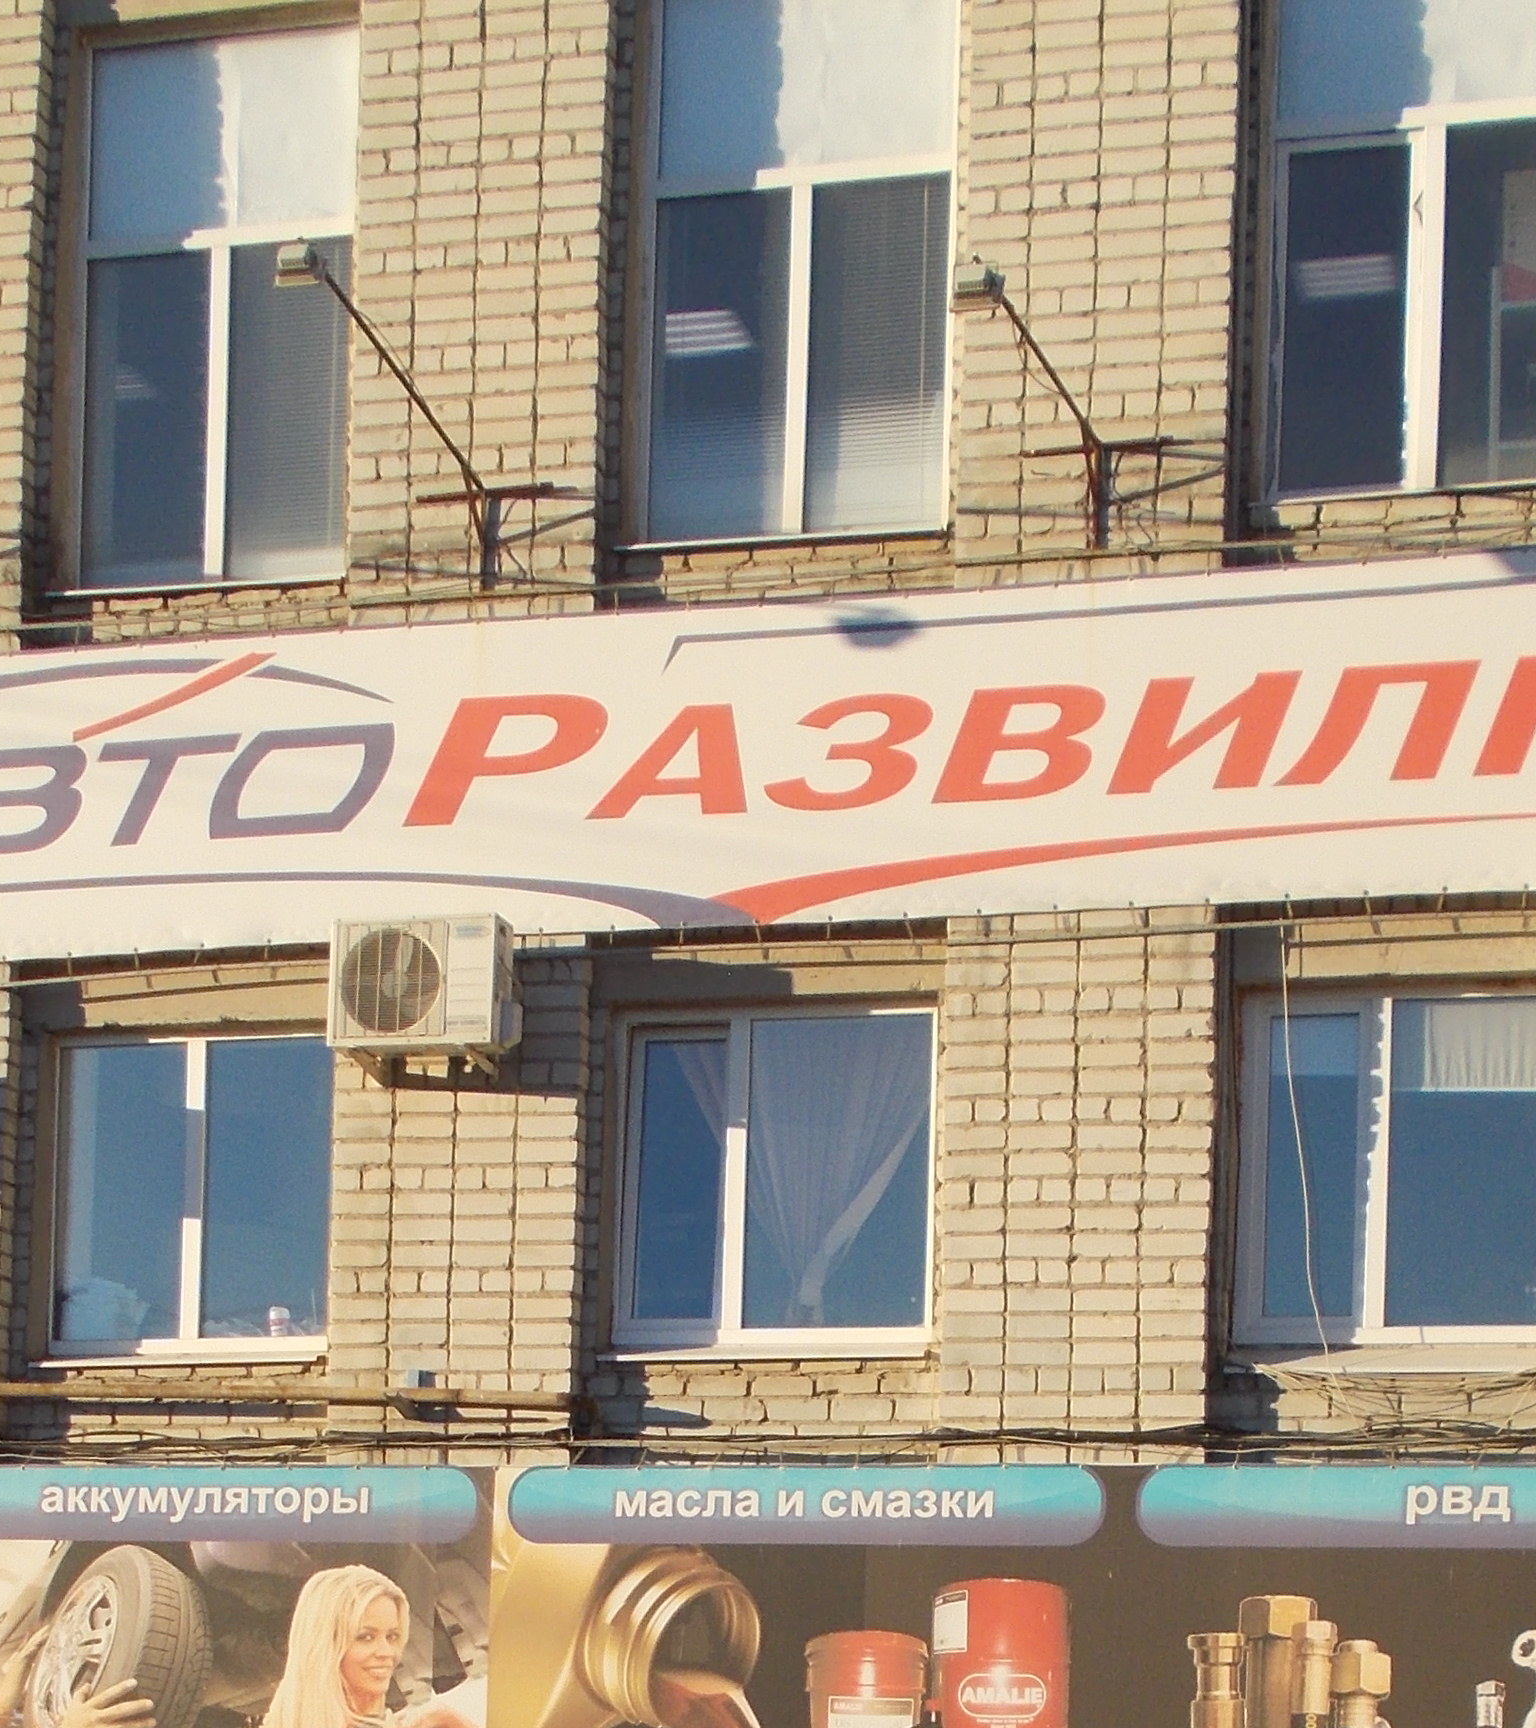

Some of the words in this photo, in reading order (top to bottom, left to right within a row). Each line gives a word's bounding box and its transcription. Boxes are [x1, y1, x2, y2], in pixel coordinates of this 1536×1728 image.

[41, 1484, 369, 1522] аккумуляторы
[614, 1487, 760, 1518] масла
[777, 1487, 805, 1518] и
[820, 1487, 996, 1518] смазки
[1405, 1483, 1512, 1524] рвд
[962, 1687, 1043, 1704] AMALIE
